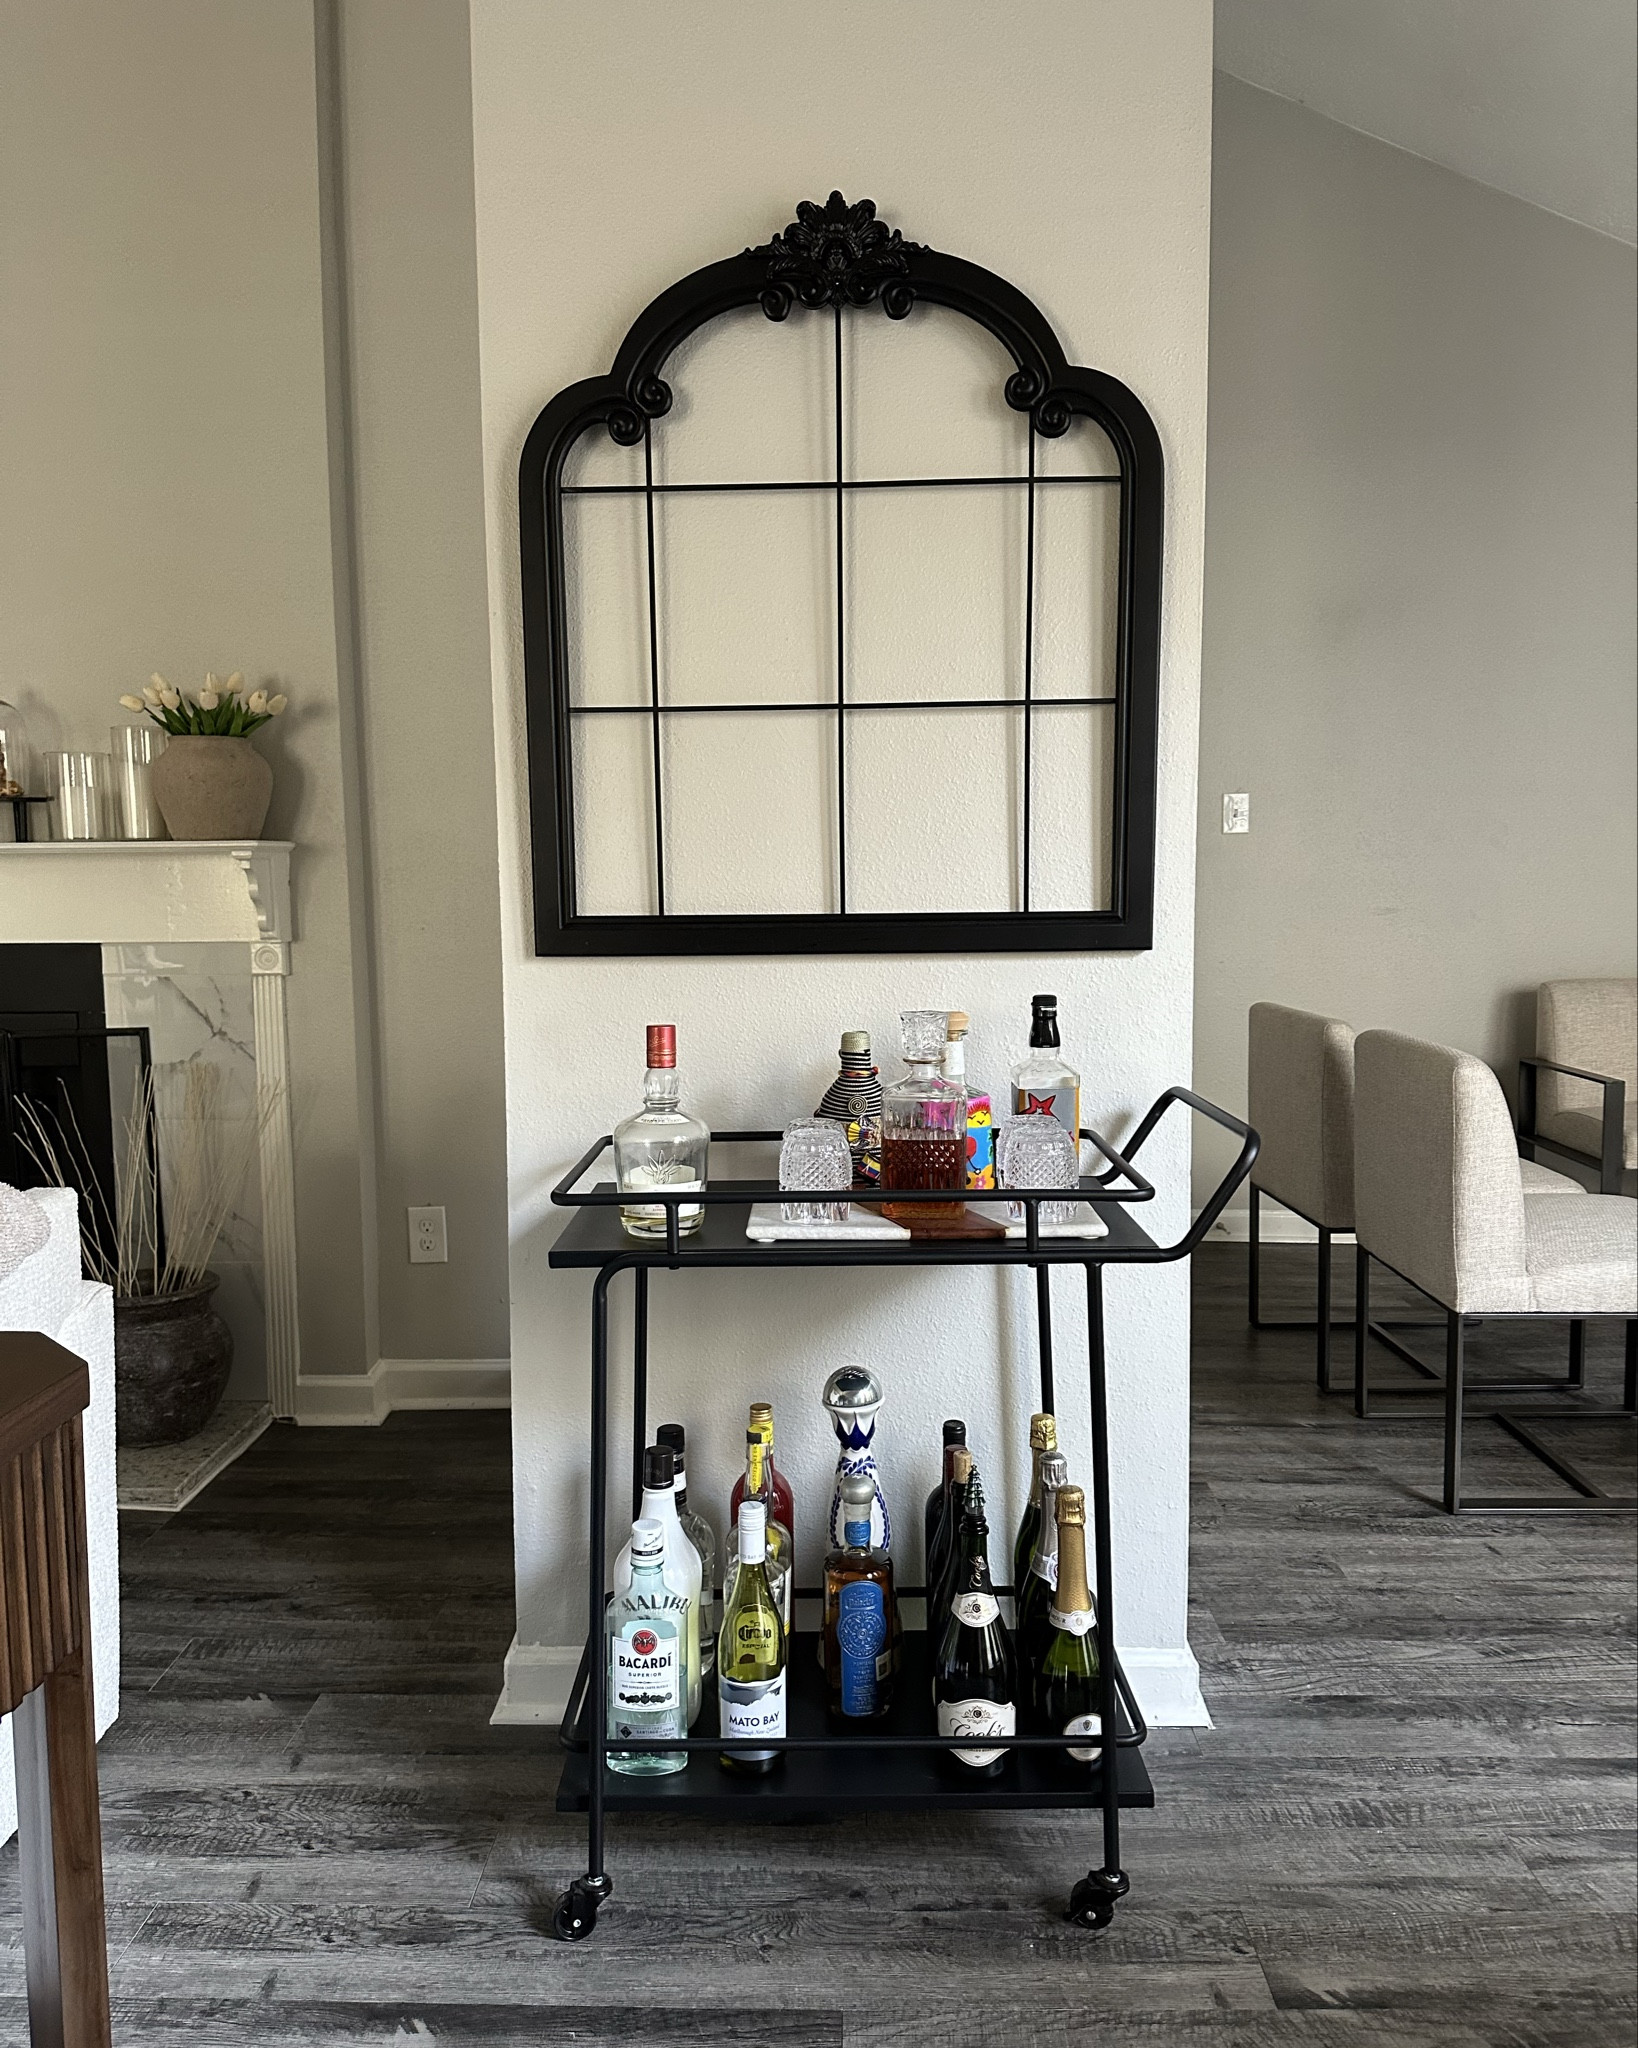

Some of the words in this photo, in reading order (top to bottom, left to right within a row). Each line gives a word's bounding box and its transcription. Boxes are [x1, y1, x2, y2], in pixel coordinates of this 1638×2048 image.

[619, 1652, 672, 1669] BACARDÍ
[728, 1714, 760, 1727] MATO
[763, 1711, 780, 1725] BAY
